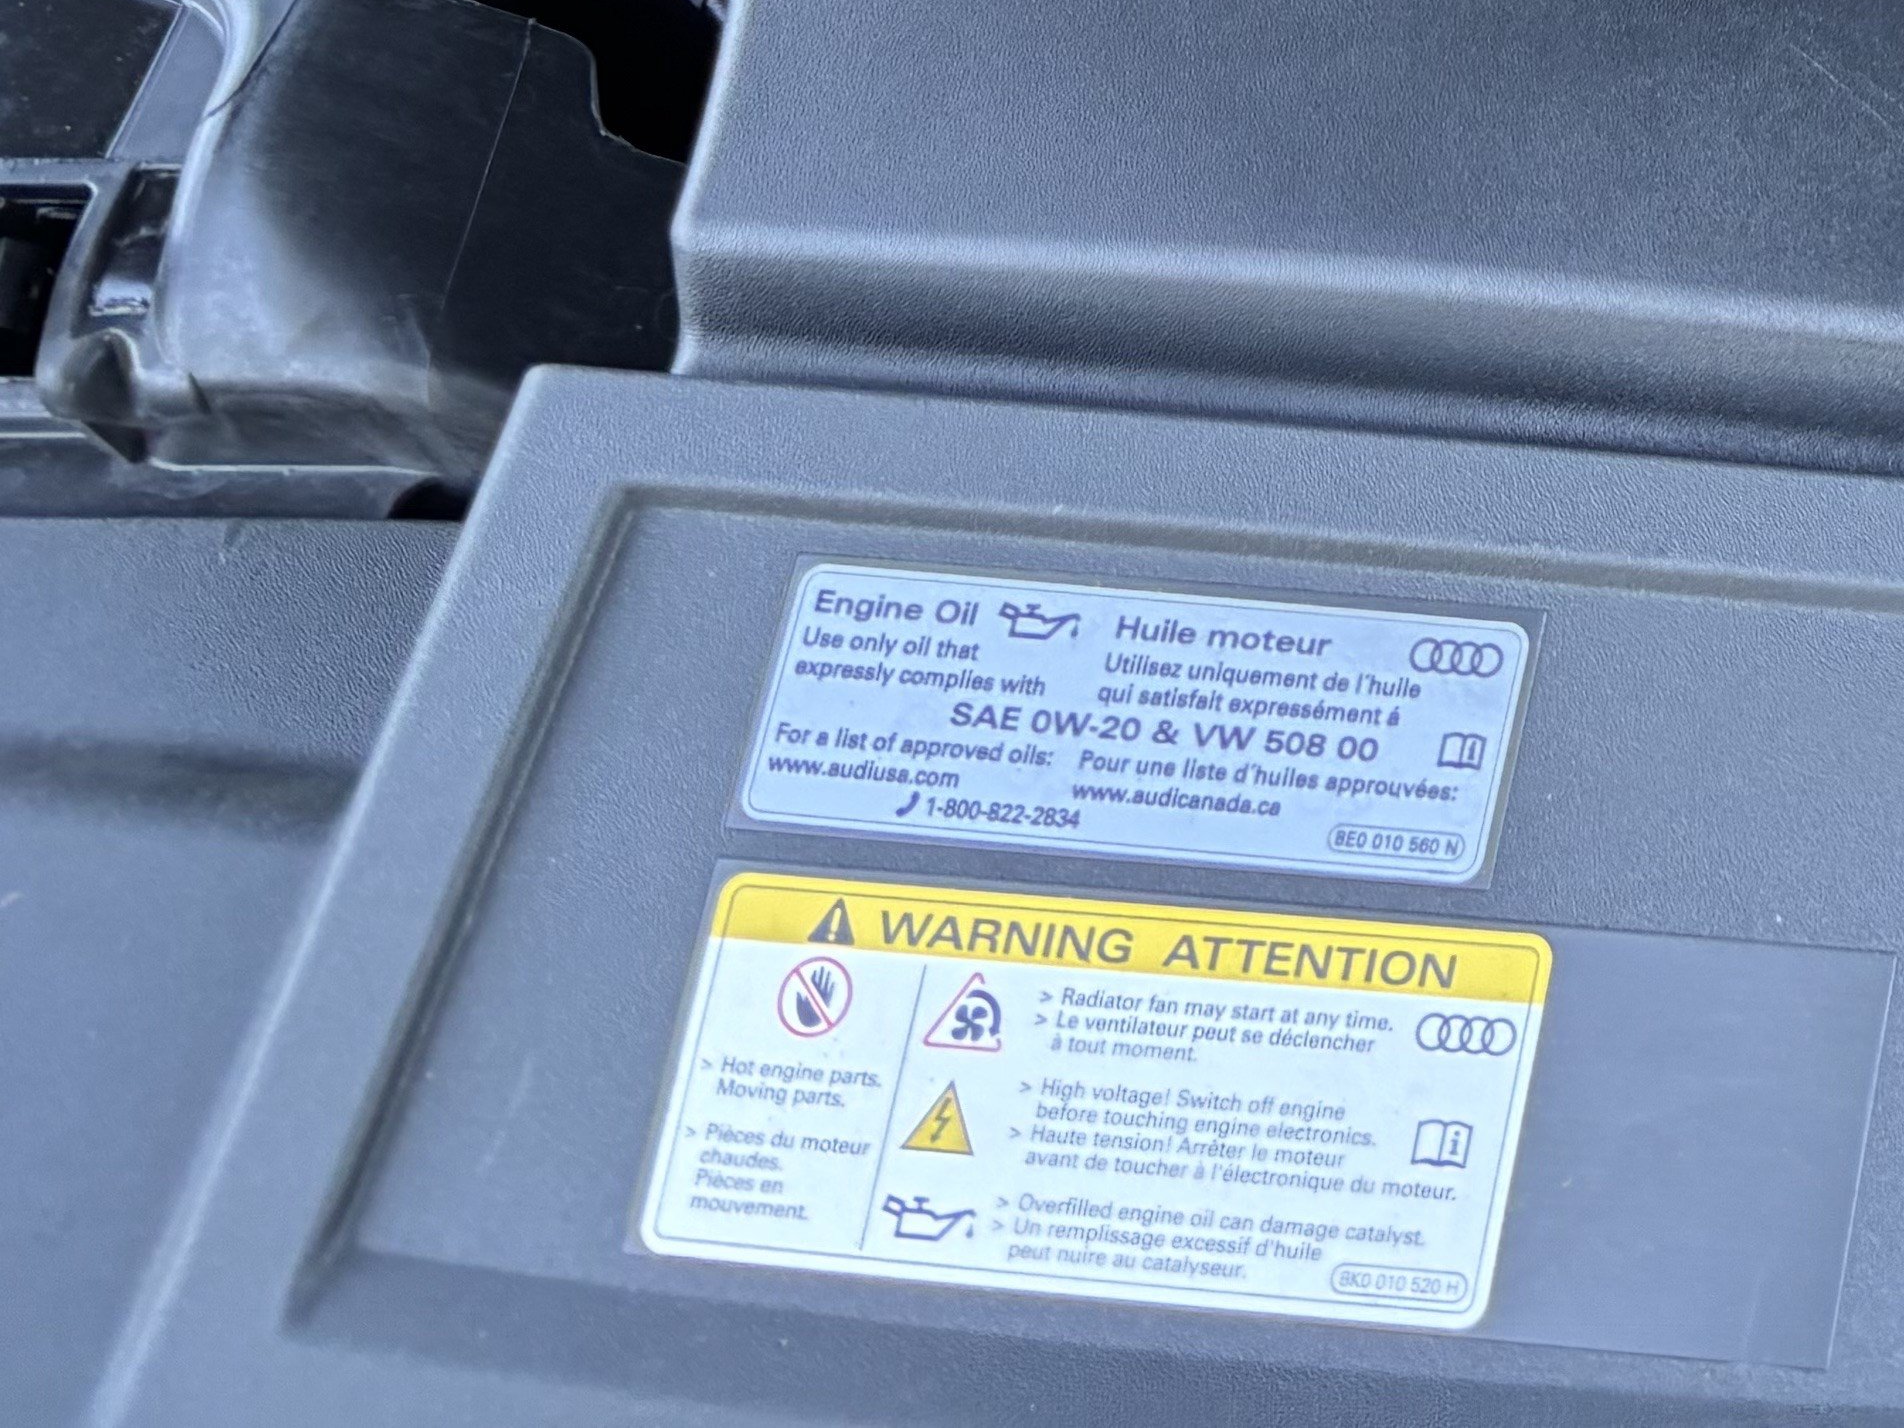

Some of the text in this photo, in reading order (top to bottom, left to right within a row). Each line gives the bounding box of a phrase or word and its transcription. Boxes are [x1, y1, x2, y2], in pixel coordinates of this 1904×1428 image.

[813, 588, 979, 626] Engine Oil
[802, 625, 980, 661] Use only oil that
[1114, 614, 1332, 656] Huile moteur
[794, 659, 1045, 696] expressly complies with
[1104, 652, 1182, 678] Utilisez
[1187, 660, 1318, 690] uniquement
[1321, 670, 1349, 692] de
[1097, 682, 1134, 706] qui
[1227, 697, 1382, 726] expressément
[774, 721, 1054, 766] For a list of approved oils:
[949, 701, 1379, 762] SAE 0W-20 & VW 508 00
[768, 756, 960, 788] www.audiusa.com
[1077, 748, 1131, 773] Pour
[1134, 759, 1176, 777] une
[1181, 757, 1227, 782] liste
[1324, 775, 1459, 801] approuvées:
[926, 796, 1080, 828] 1-800-822-2834
[1071, 783, 1281, 816] www.audicanada.ca
[1371, 832, 1404, 852] 010
[1407, 835, 1440, 854] 560
[1444, 838, 1459, 856] N
[880, 909, 1458, 989] WARNING ATTENTION
[1060, 986, 1393, 1031] Radiator fan may start at any time.
[1055, 1009, 1375, 1052] Le ventilateur peut se déclencher
[1067, 1036, 1106, 1055] tout
[1111, 1041, 1197, 1062] moment.
[720, 1055, 881, 1087] Hot engine parts.
[715, 1077, 845, 1107] Moving parts.
[1040, 1077, 1345, 1123] High voltage! Switch off engine
[1035, 1101, 1376, 1146] before touching engine electronics.
[698, 1146, 782, 1171] chaudes.
[769, 1130, 795, 1149] du
[799, 1136, 871, 1155] moteur
[1030, 1123, 1087, 1146] Haute
[1092, 1131, 1172, 1152] tension!
[1250, 1142, 1268, 1162] le
[1273, 1148, 1345, 1167] moteur
[758, 1179, 784, 1194] en
[1023, 1150, 1079, 1168] avant
[1083, 1153, 1108, 1171] de
[1113, 1156, 1188, 1178] toucher
[1349, 1175, 1375, 1194] du
[1381, 1181, 1456, 1201] moteur.
[689, 1195, 808, 1220] mouvement.
[1018, 1192, 1424, 1247] Overfilled engine oil can damage catalyst.
[1013, 1217, 1042, 1235] Un
[1046, 1223, 1166, 1251] remplissage
[1170, 1234, 1252, 1254] excessif
[1007, 1244, 1245, 1278] peut nuire au catalyseur.
[1374, 1272, 1407, 1292] 010
[1410, 1276, 1442, 1295] 520
